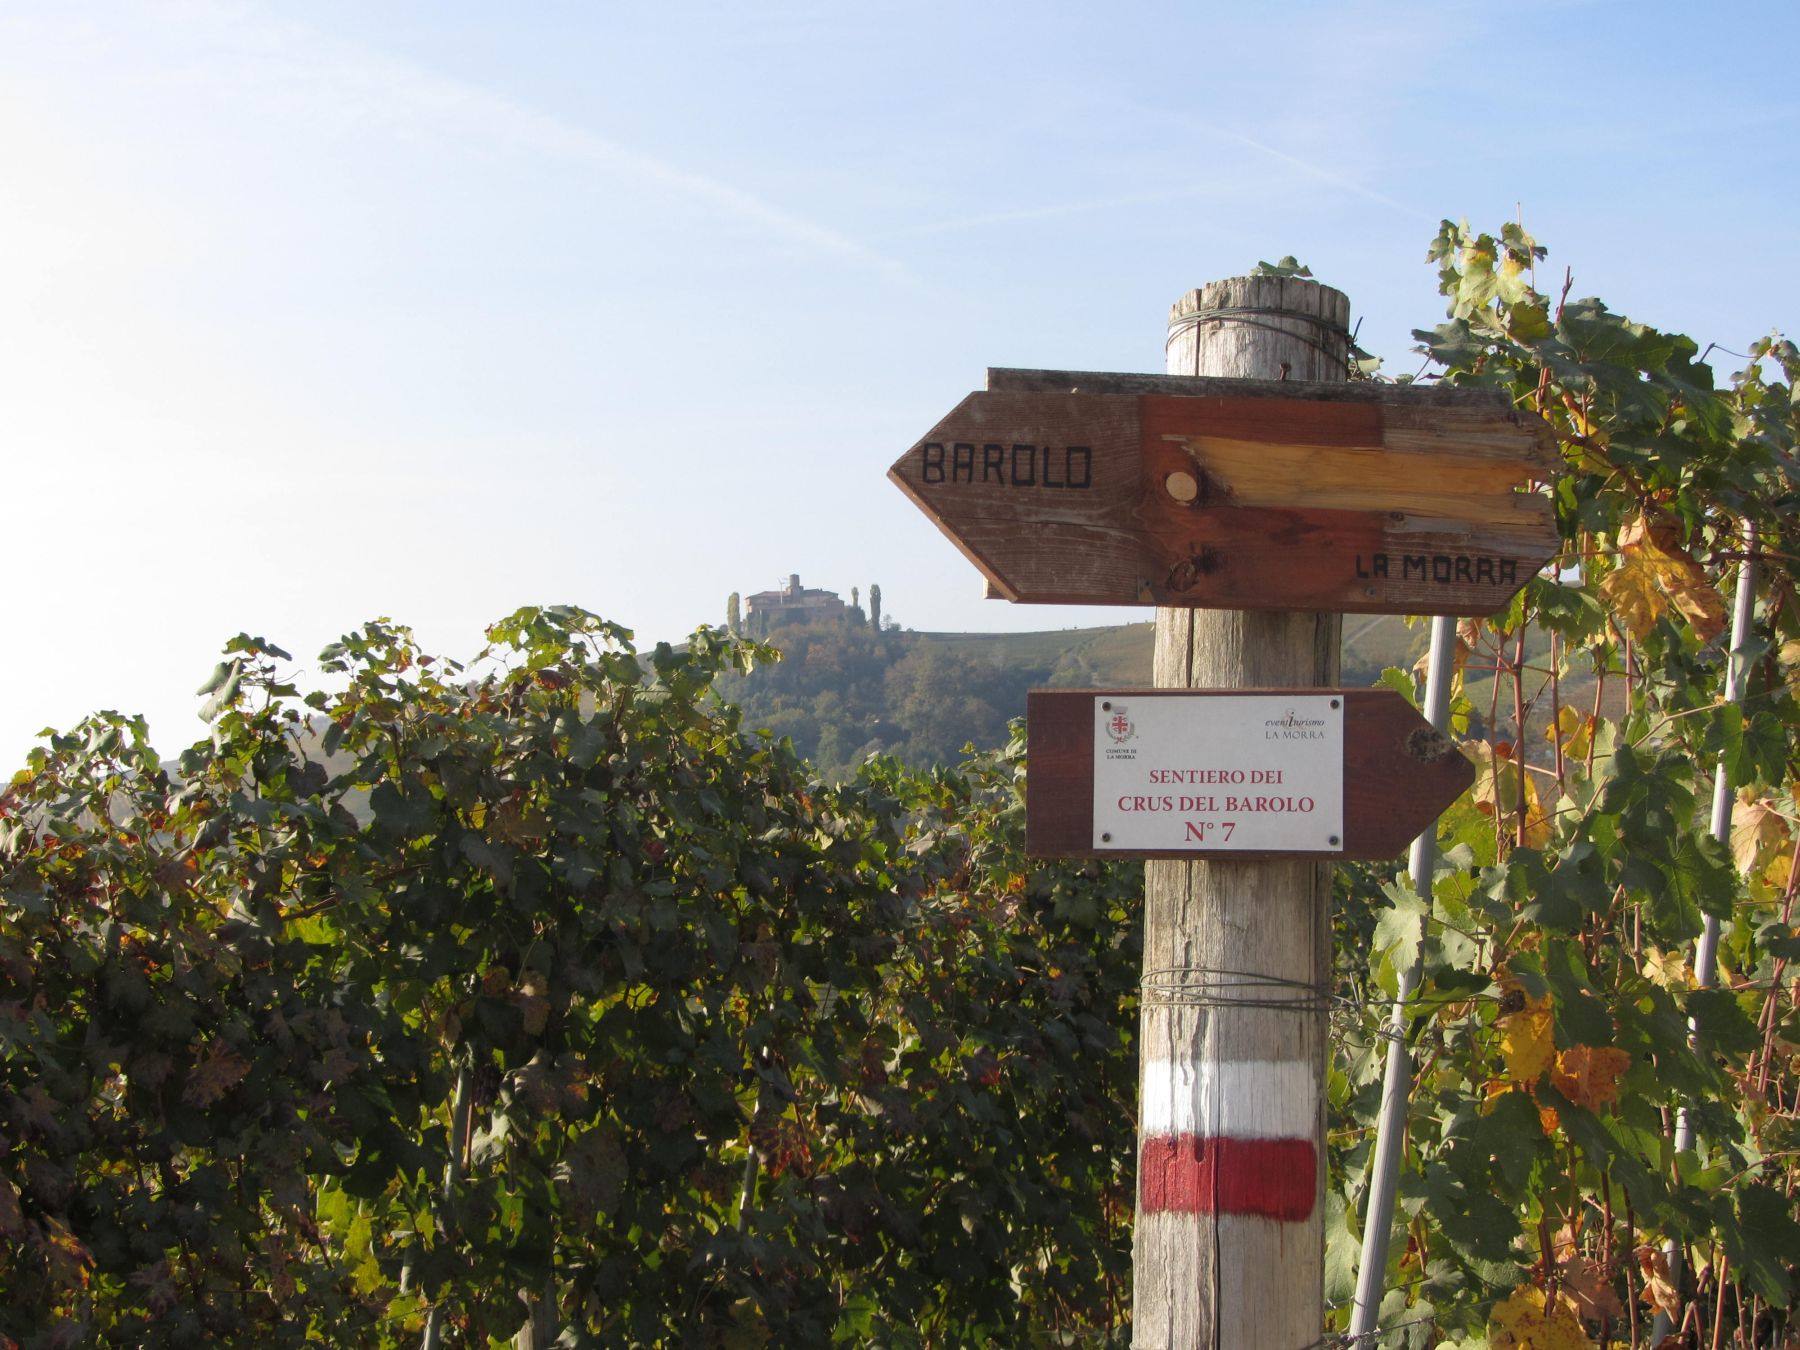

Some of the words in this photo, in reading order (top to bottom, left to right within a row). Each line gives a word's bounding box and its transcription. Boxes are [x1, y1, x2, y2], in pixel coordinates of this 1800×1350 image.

[922, 442, 1092, 489] BAROLO
[1356, 553, 1388, 579] LA
[1403, 554, 1518, 586] MORRA
[1265, 731, 1279, 740] LA
[1283, 731, 1325, 740] MORRA
[1149, 769, 1245, 785] SENTIERO
[1250, 769, 1284, 784] DEI
[1117, 796, 1173, 812] CRUS
[1179, 796, 1220, 812] DEL
[1226, 796, 1315, 813] BAROLO
[1184, 821, 1214, 842] N°
[1221, 821, 1236, 842] 7
